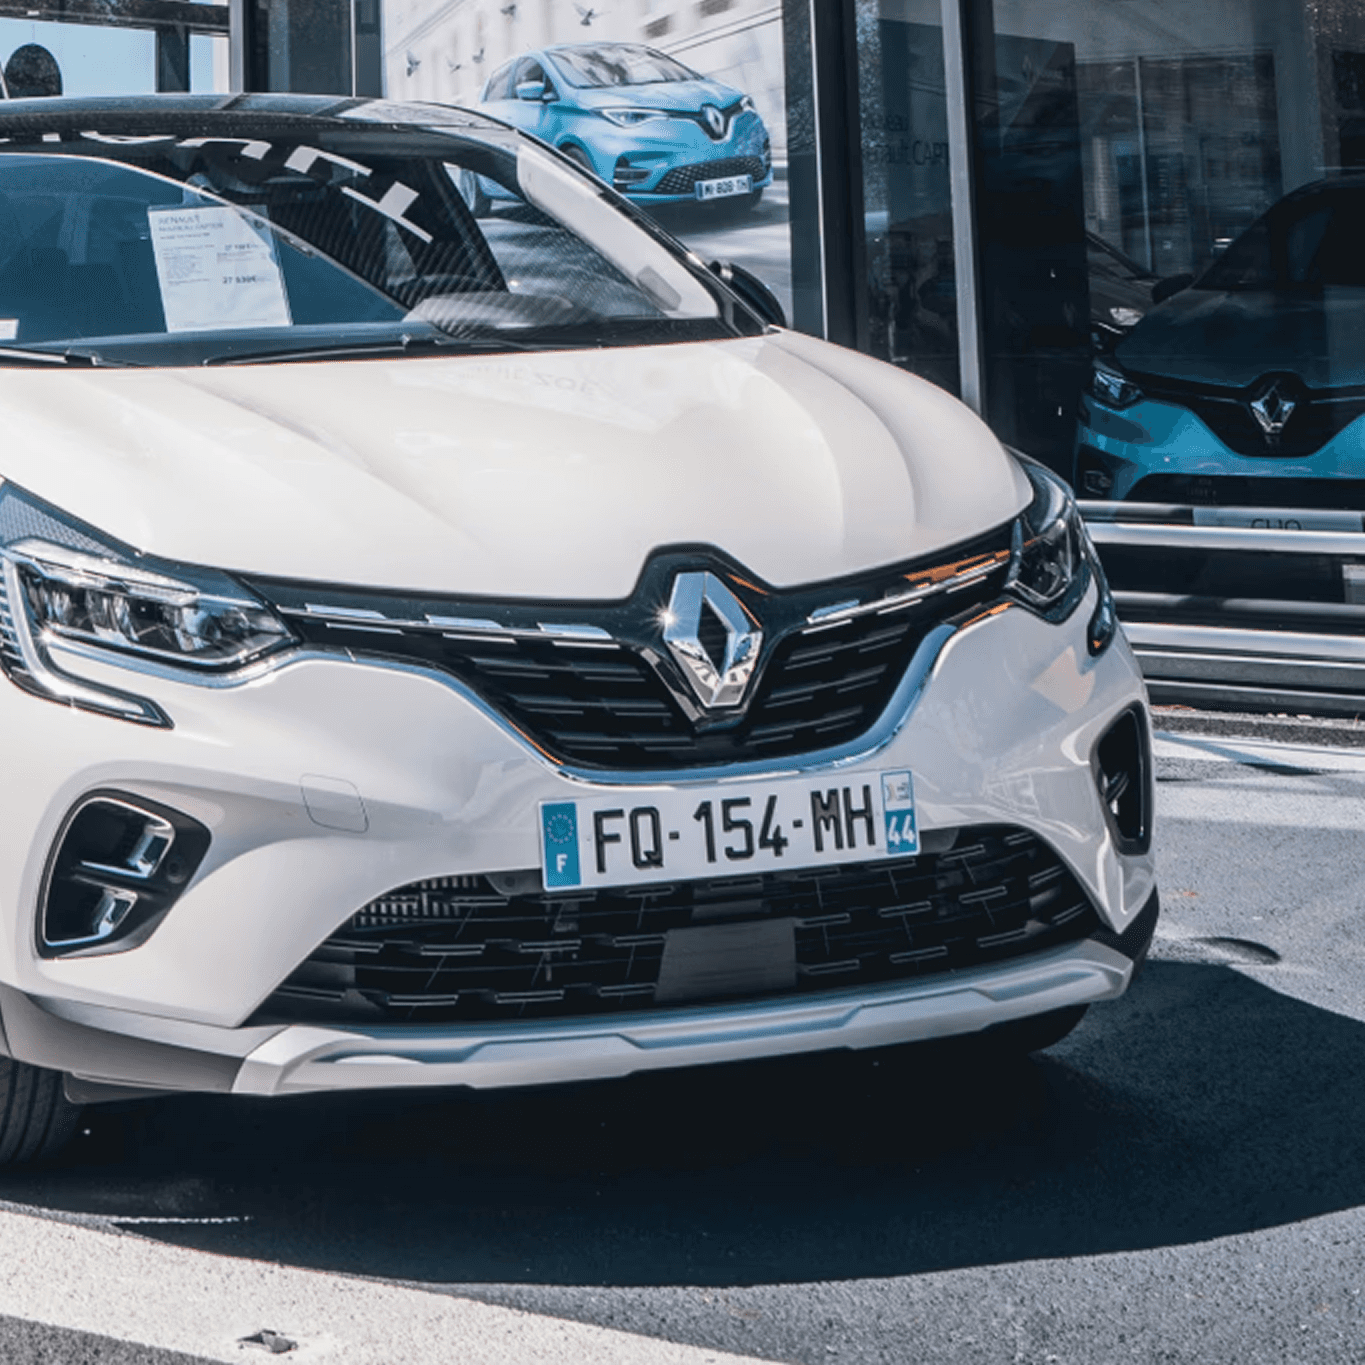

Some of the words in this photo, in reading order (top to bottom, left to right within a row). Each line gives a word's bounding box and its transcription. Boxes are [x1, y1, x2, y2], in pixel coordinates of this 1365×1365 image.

[593, 784, 876, 874] FQ-154-MH
[888, 814, 916, 846] 44
[555, 854, 568, 873] F
